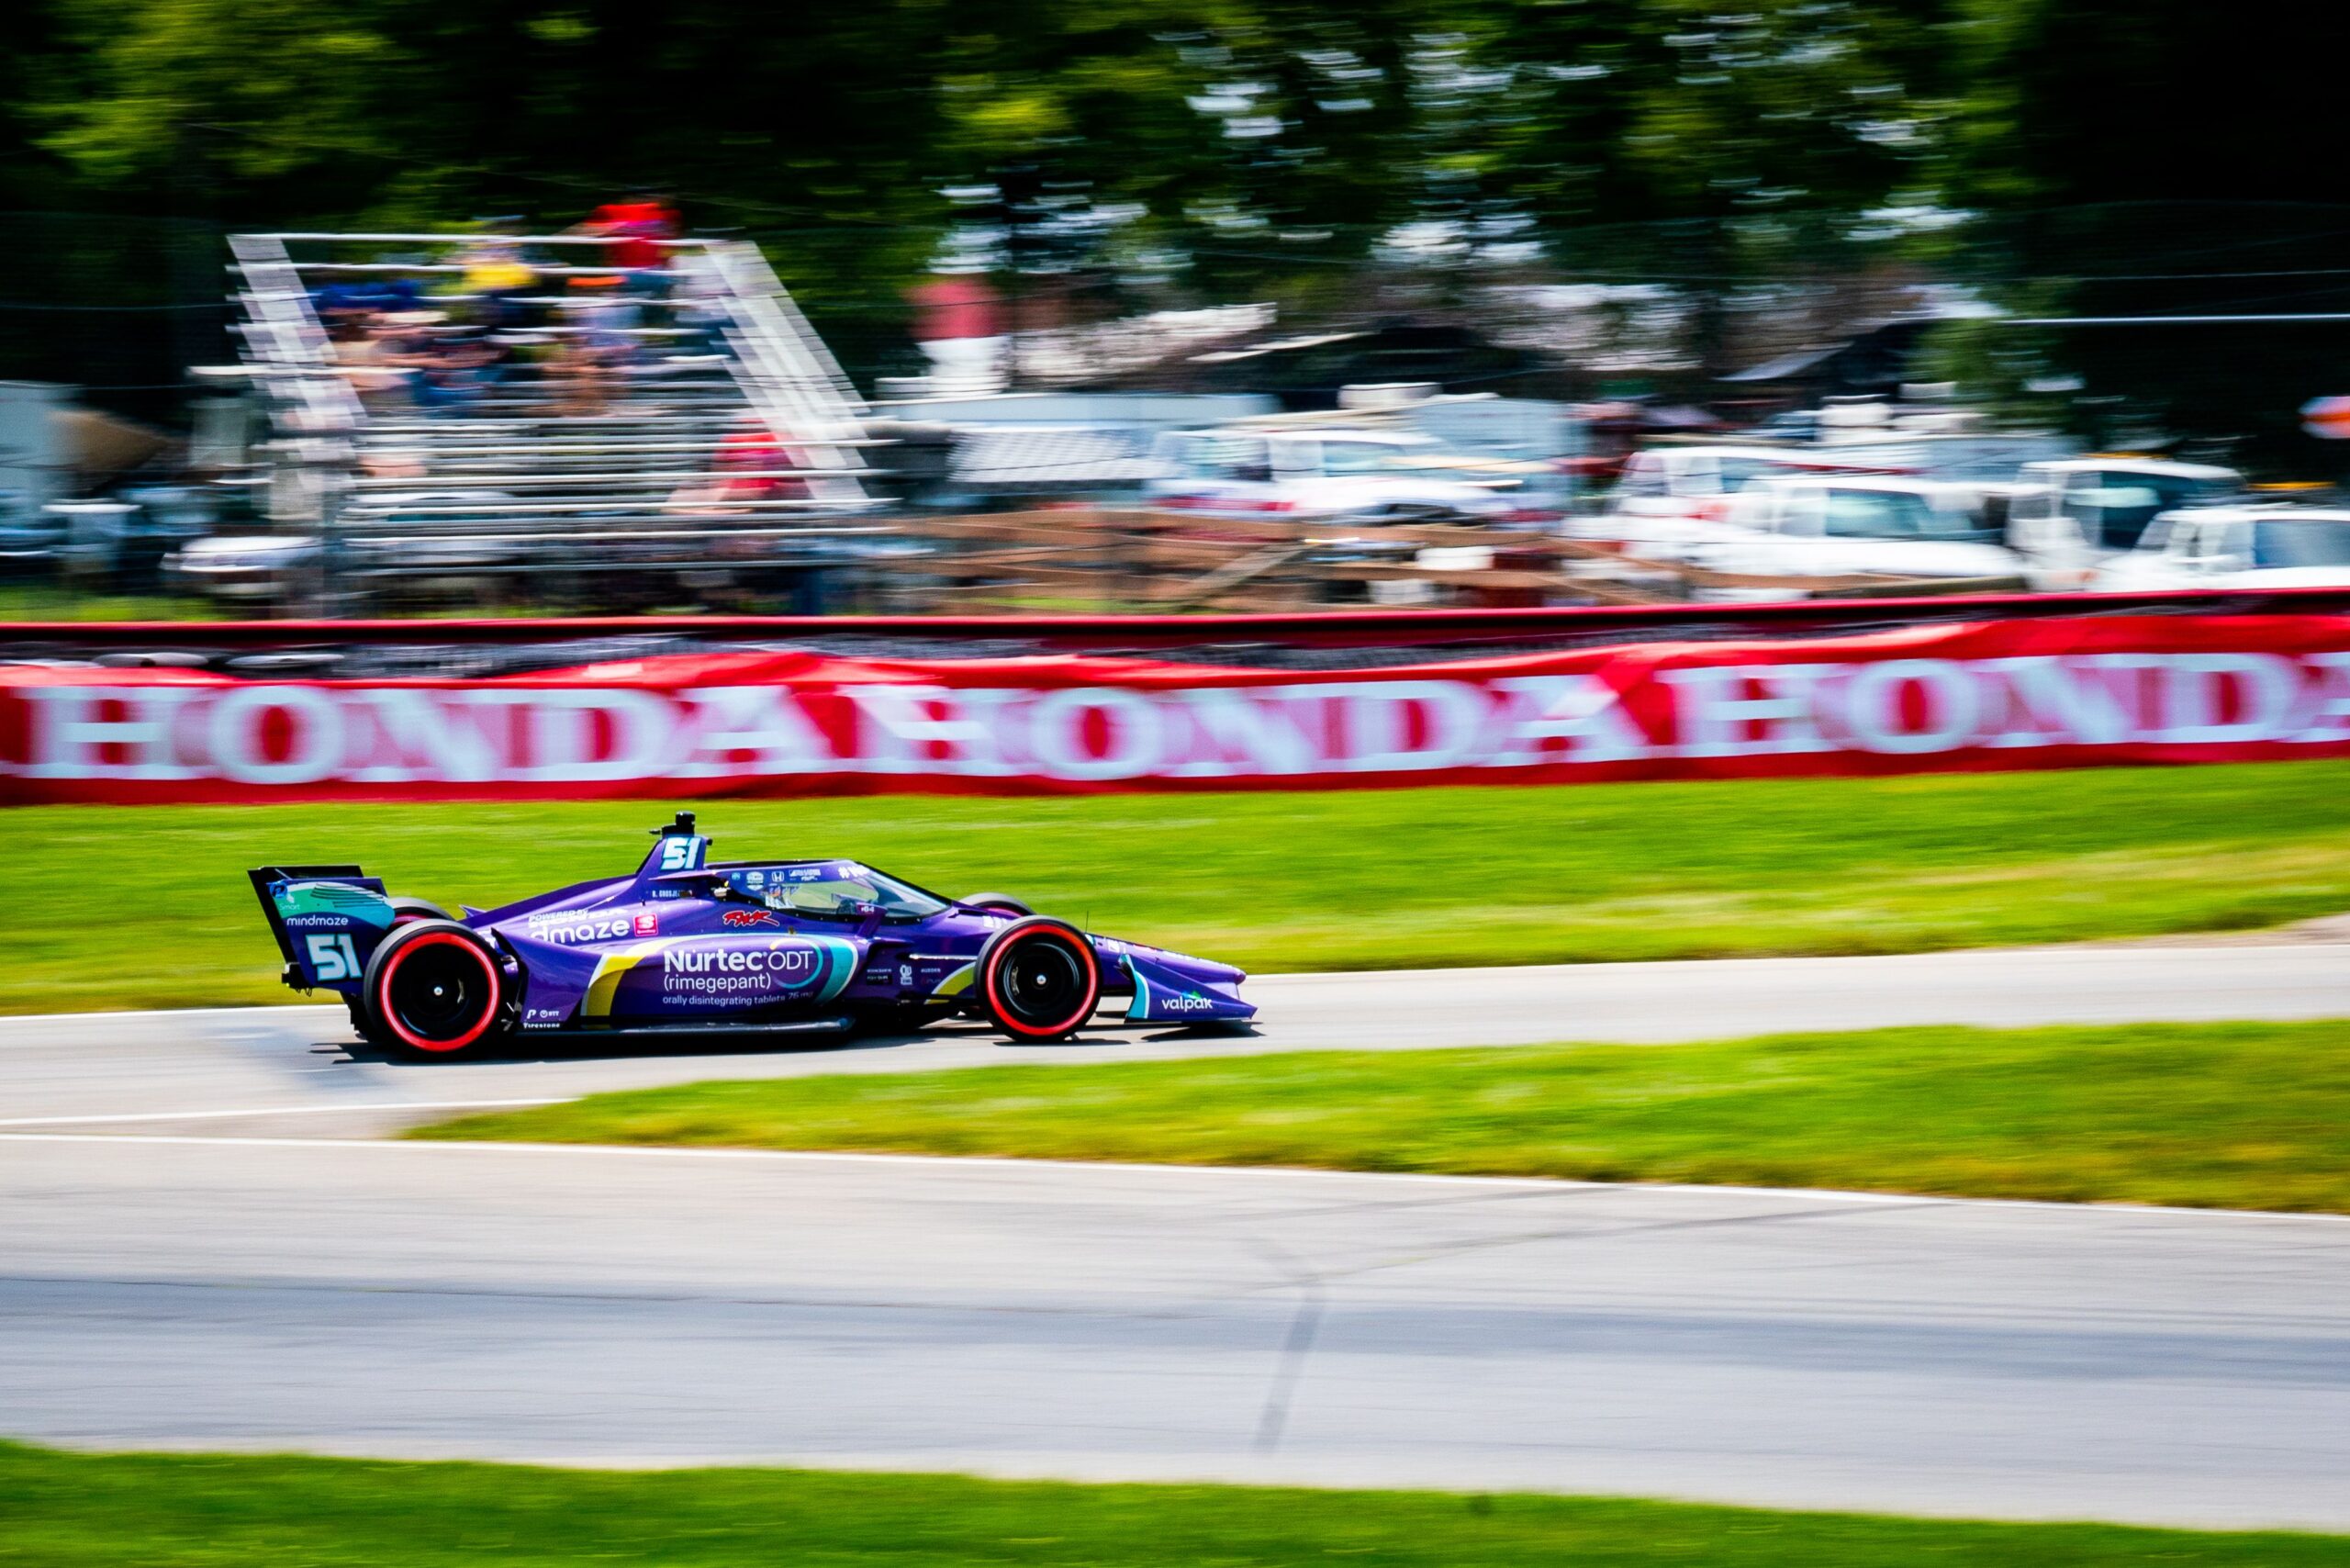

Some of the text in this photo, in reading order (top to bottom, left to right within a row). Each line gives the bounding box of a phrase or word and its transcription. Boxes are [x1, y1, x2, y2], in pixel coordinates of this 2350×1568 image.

[23, 684, 831, 784] HONDA
[840, 675, 1643, 781] HONDA
[661, 836, 701, 870] 51
[286, 914, 349, 926] mindmaze
[306, 934, 363, 981] 51
[768, 950, 814, 970] ODT
[664, 972, 772, 992] (rimegepant)
[663, 994, 688, 1005] orally
[689, 995, 753, 1007] disintegrating
[755, 993, 785, 1003] tablets
[1162, 995, 1214, 1012] valpak
